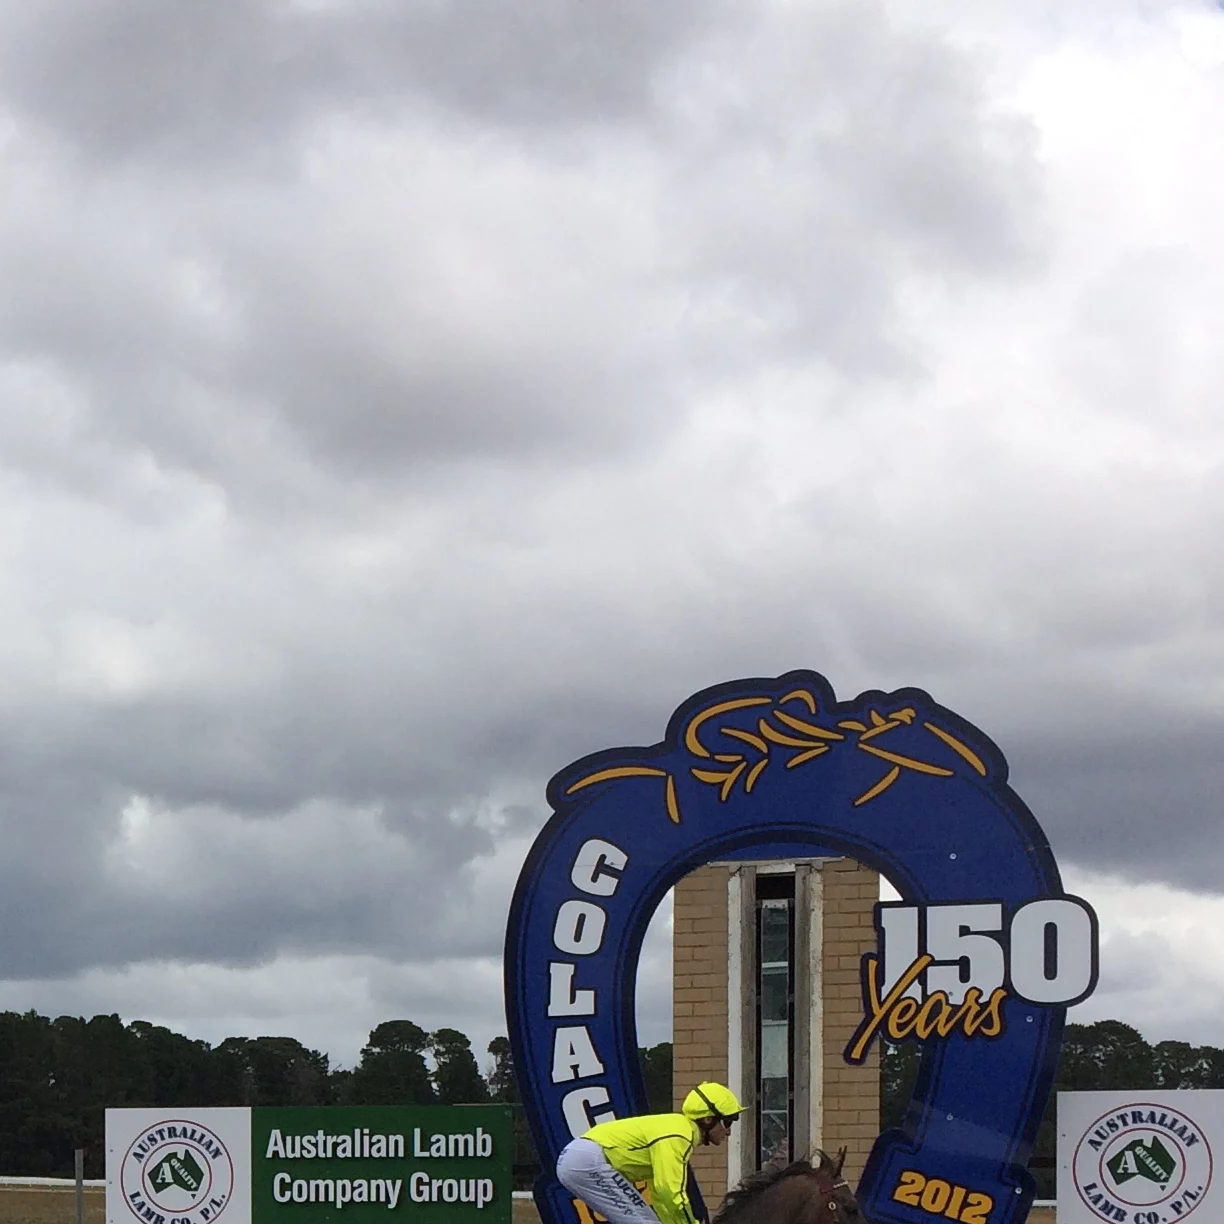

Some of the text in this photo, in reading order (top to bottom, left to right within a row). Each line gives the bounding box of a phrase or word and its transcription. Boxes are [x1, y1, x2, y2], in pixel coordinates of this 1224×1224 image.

[880, 899, 1091, 1006] 150
[853, 954, 1007, 1060] Years
[132, 1126, 223, 1164] AUSTRALIAN
[266, 1127, 493, 1159] Australian Lamb
[1088, 1110, 1199, 1152] AUSTRALIAN
[170, 1158, 198, 1189] QUALITY
[1134, 1146, 1169, 1180] QUALITY
[273, 1171, 494, 1209] Company Group
[1083, 1182, 1127, 1222] LAMB
